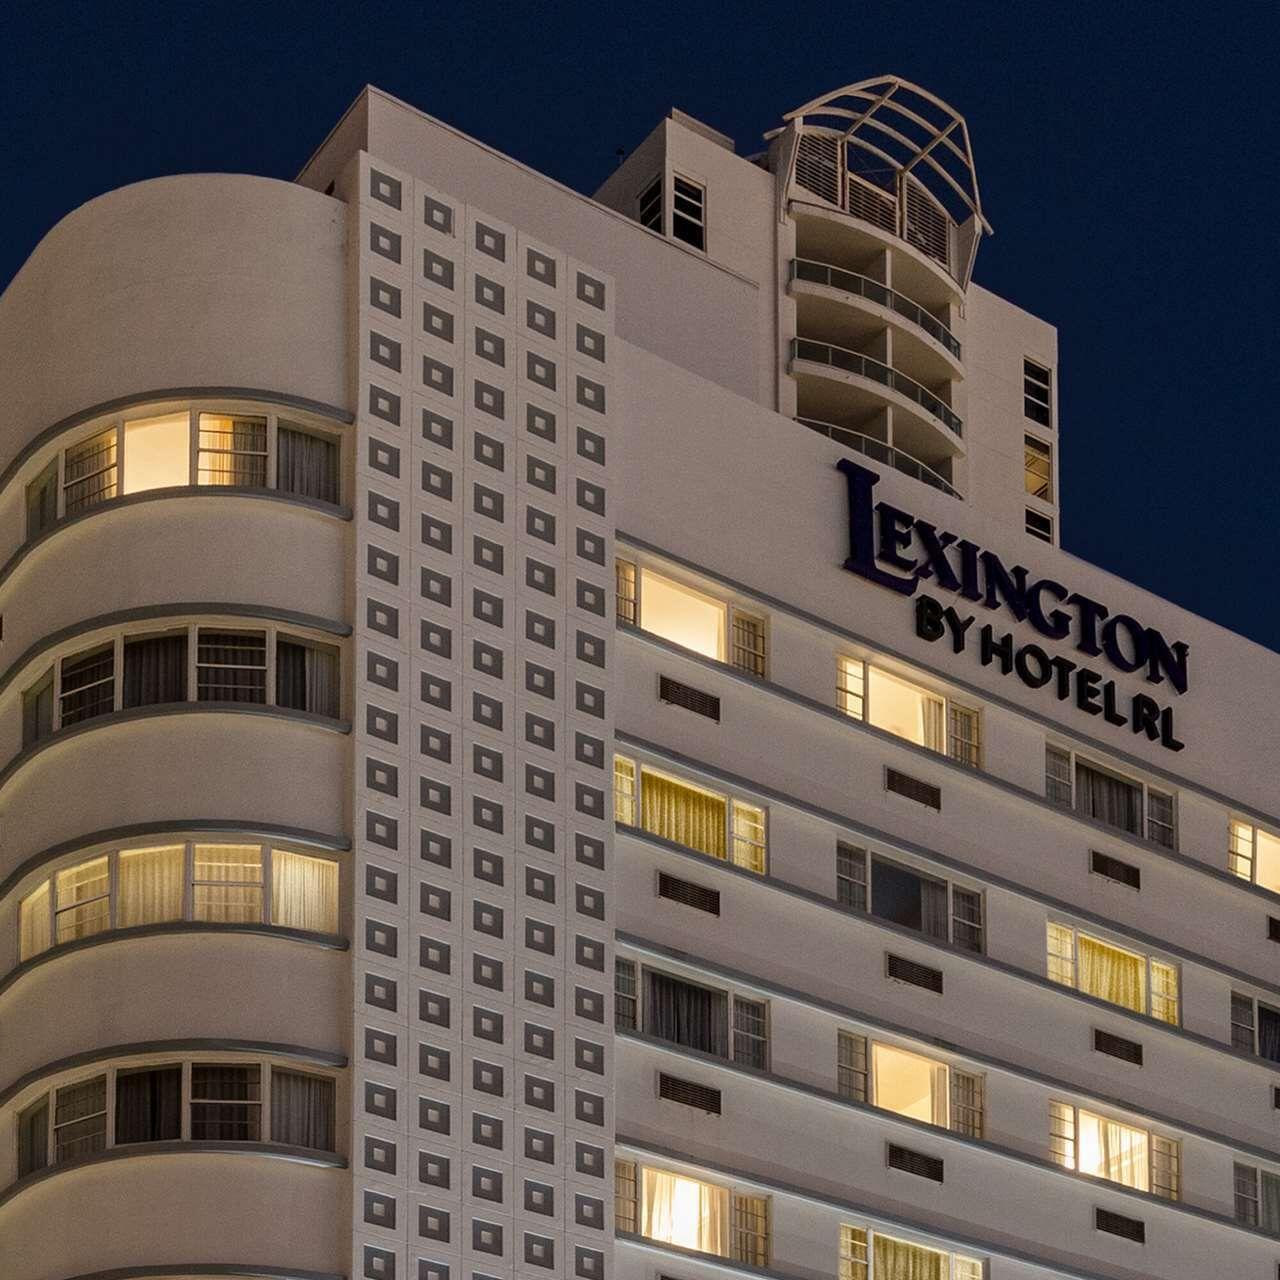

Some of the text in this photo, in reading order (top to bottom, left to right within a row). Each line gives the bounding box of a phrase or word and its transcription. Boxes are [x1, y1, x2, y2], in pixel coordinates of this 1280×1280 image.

[836, 457, 1190, 695] LEXINGTON
[915, 594, 976, 654] BY
[980, 624, 1128, 727] HOTEL
